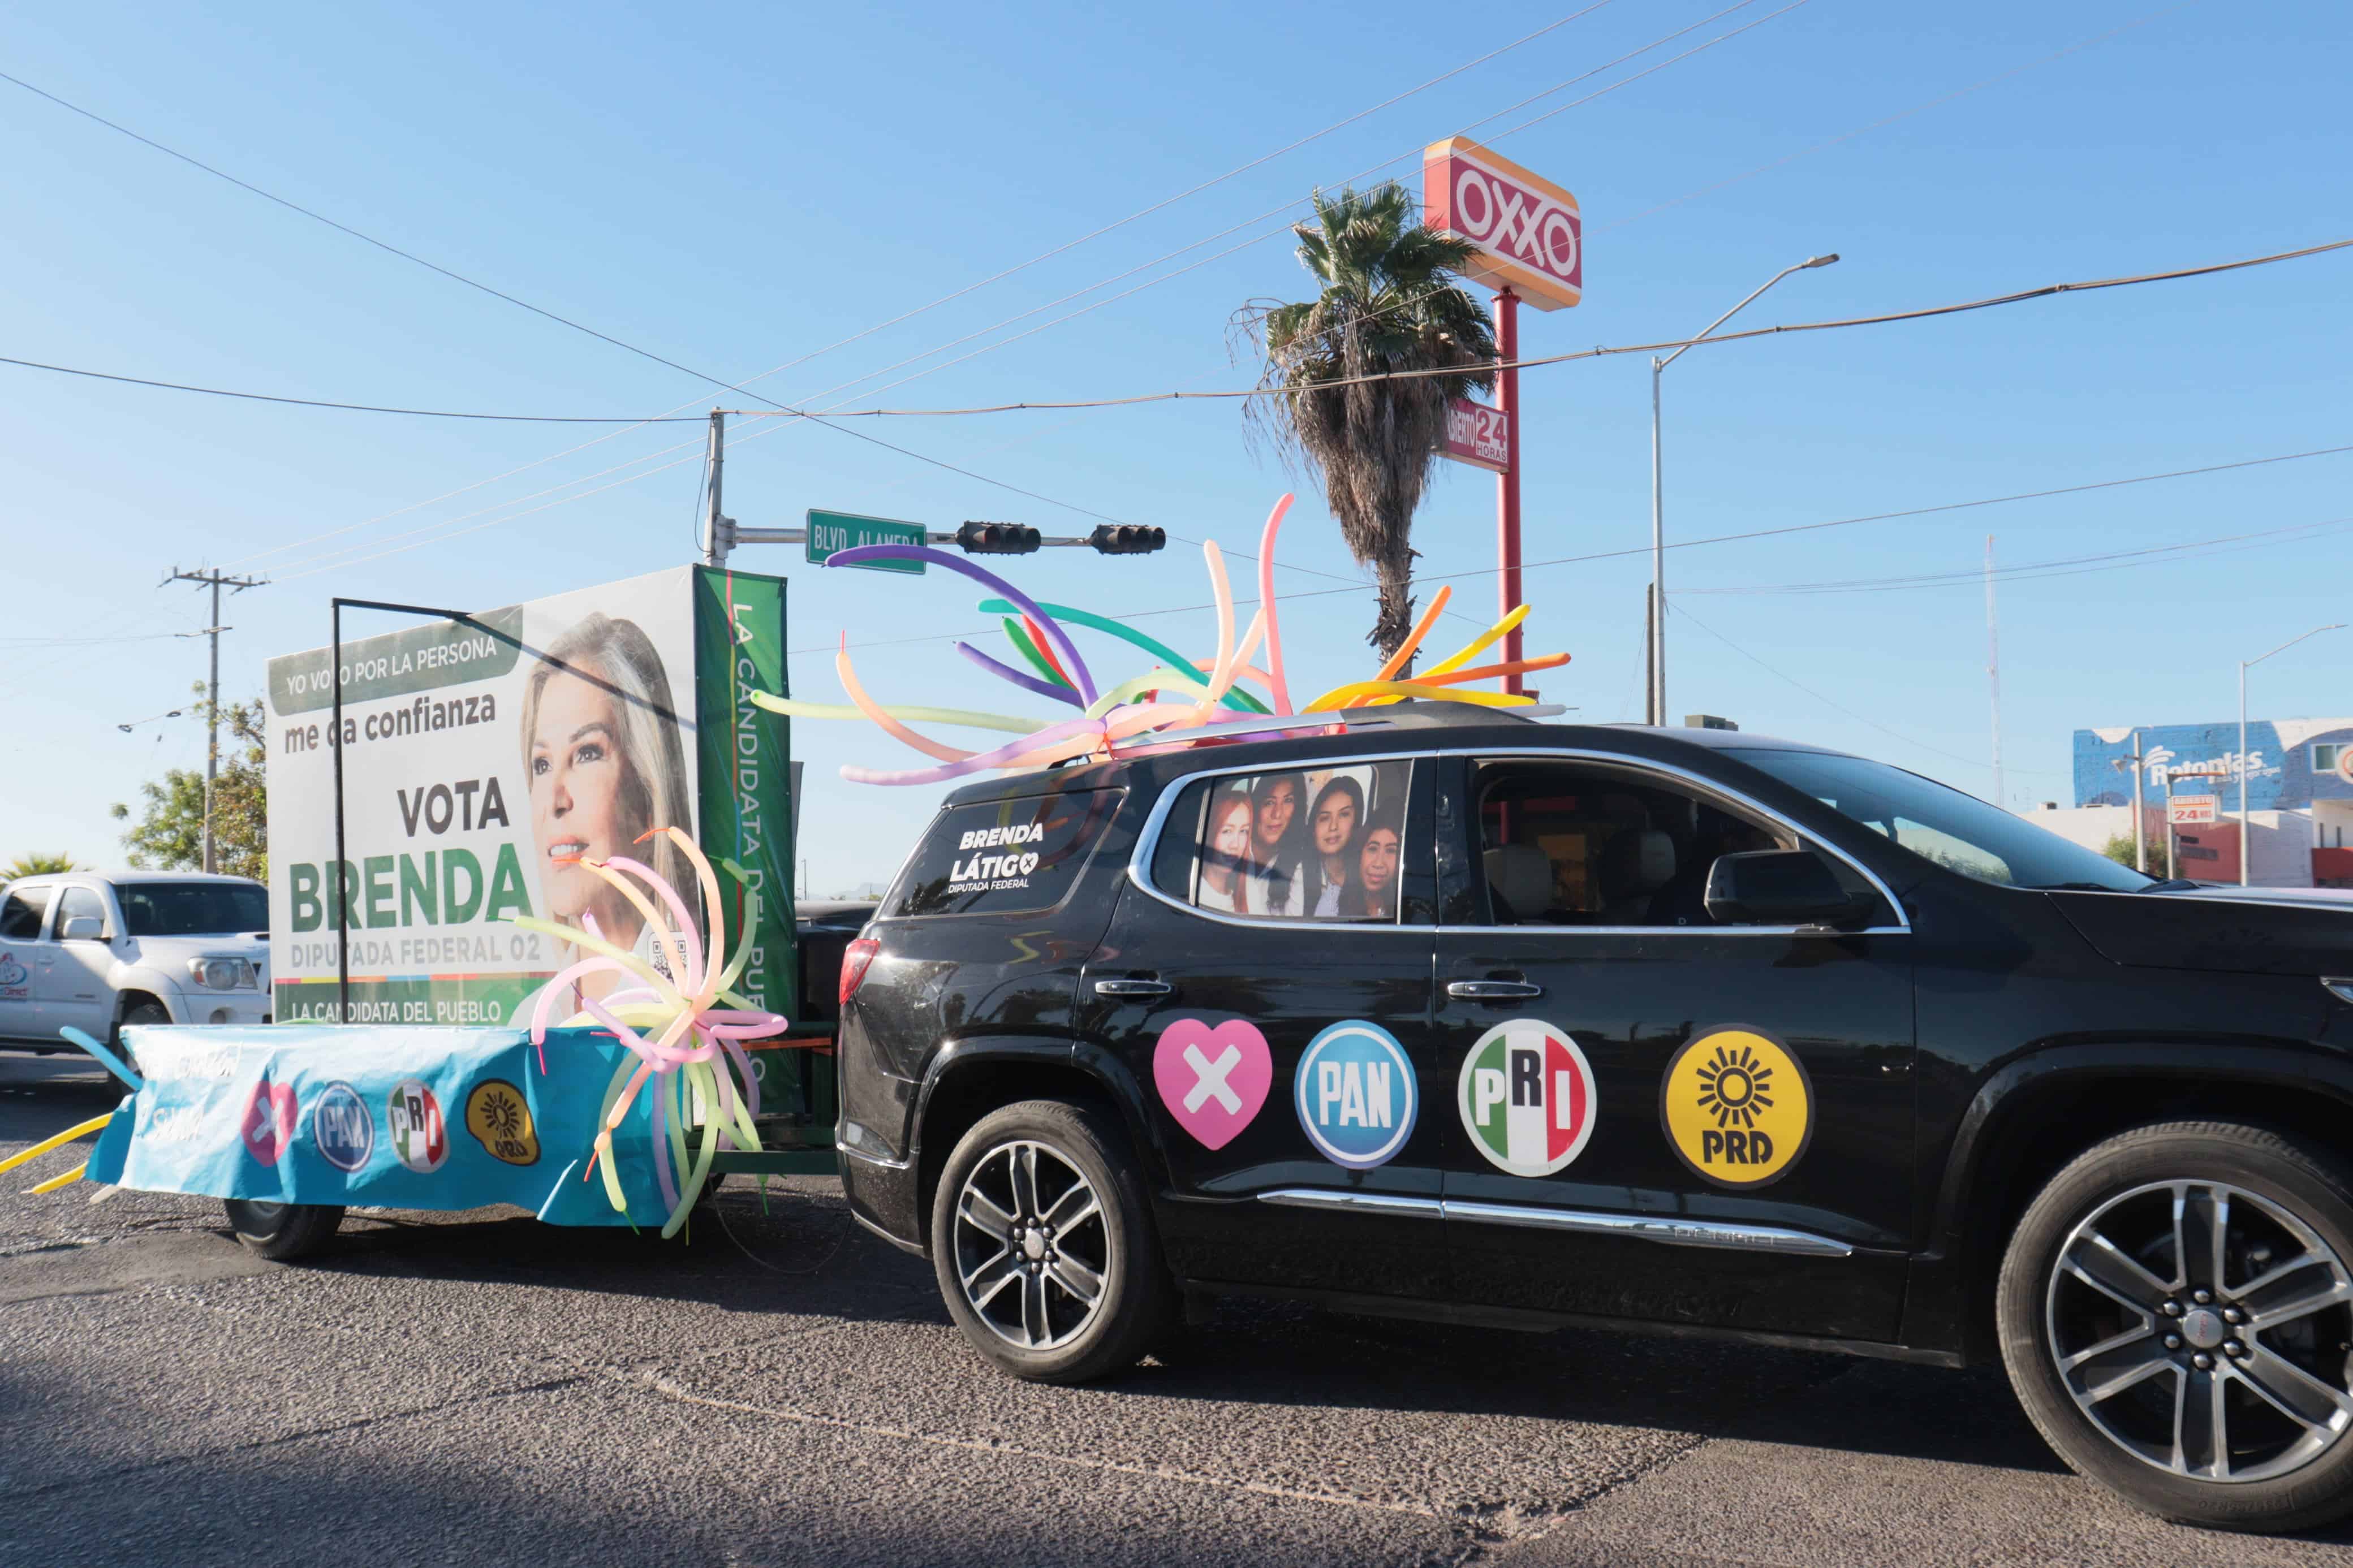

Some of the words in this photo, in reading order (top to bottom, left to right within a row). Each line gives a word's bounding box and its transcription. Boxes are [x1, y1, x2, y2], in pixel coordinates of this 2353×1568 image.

[1456, 169, 1577, 277] OXXO
[1477, 410, 1506, 448] 24
[1477, 443, 1507, 461] HORAS
[815, 524, 847, 551] BLVD
[733, 603, 753, 646] LA
[286, 674, 306, 696] YO
[311, 665, 351, 691] VOO
[355, 658, 387, 683] POR
[392, 653, 412, 676] LA
[417, 636, 497, 671] PERSONA
[285, 724, 319, 754] me
[365, 694, 495, 741] confianza
[737, 658, 761, 856] CANDIDATA
[2151, 751, 2263, 786] Rotoplas
[397, 776, 510, 837] VOTA
[2174, 809, 2199, 820] 24
[959, 823, 1043, 850] BRENDA
[290, 843, 535, 932] BRENDA
[948, 882, 989, 893] DIPUTADA
[990, 878, 1029, 890] FEDERAL
[291, 940, 394, 968] DIPUADA
[400, 935, 503, 965] FEDERAL
[510, 932, 541, 961] 02
[292, 1002, 311, 1020] LA
[403, 1001, 433, 1022] DEL
[437, 1000, 501, 1022] PUEBLO
[745, 947, 766, 1082] PUEO
[1318, 1060, 1391, 1128] PAN
[1475, 1049, 1571, 1130] PRI
[323, 1105, 365, 1148] PAN
[393, 1095, 437, 1147] PRI
[1703, 1130, 1773, 1165] PRD
